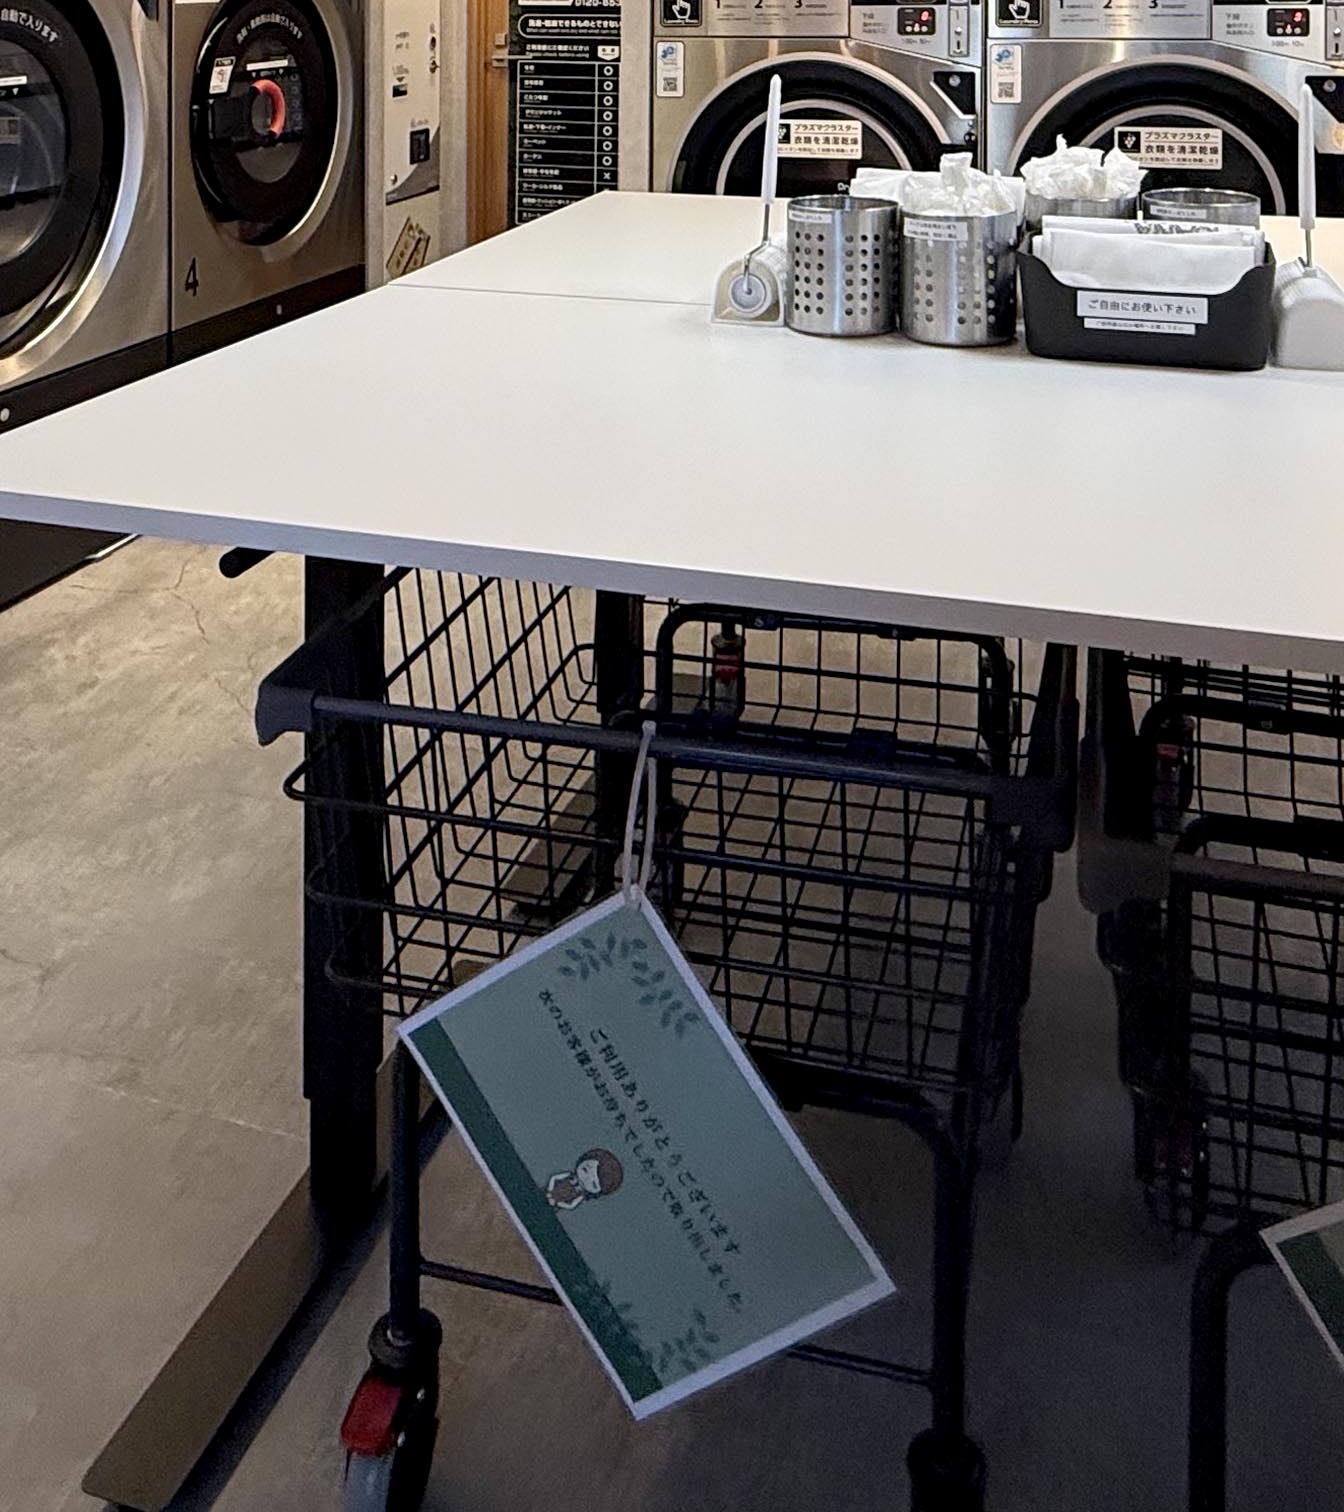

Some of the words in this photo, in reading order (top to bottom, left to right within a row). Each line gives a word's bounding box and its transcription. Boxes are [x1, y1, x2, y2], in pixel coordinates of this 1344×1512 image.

[184, 257, 200, 297] 4
[1088, 298, 1197, 316] ご自由にお使い下さい
